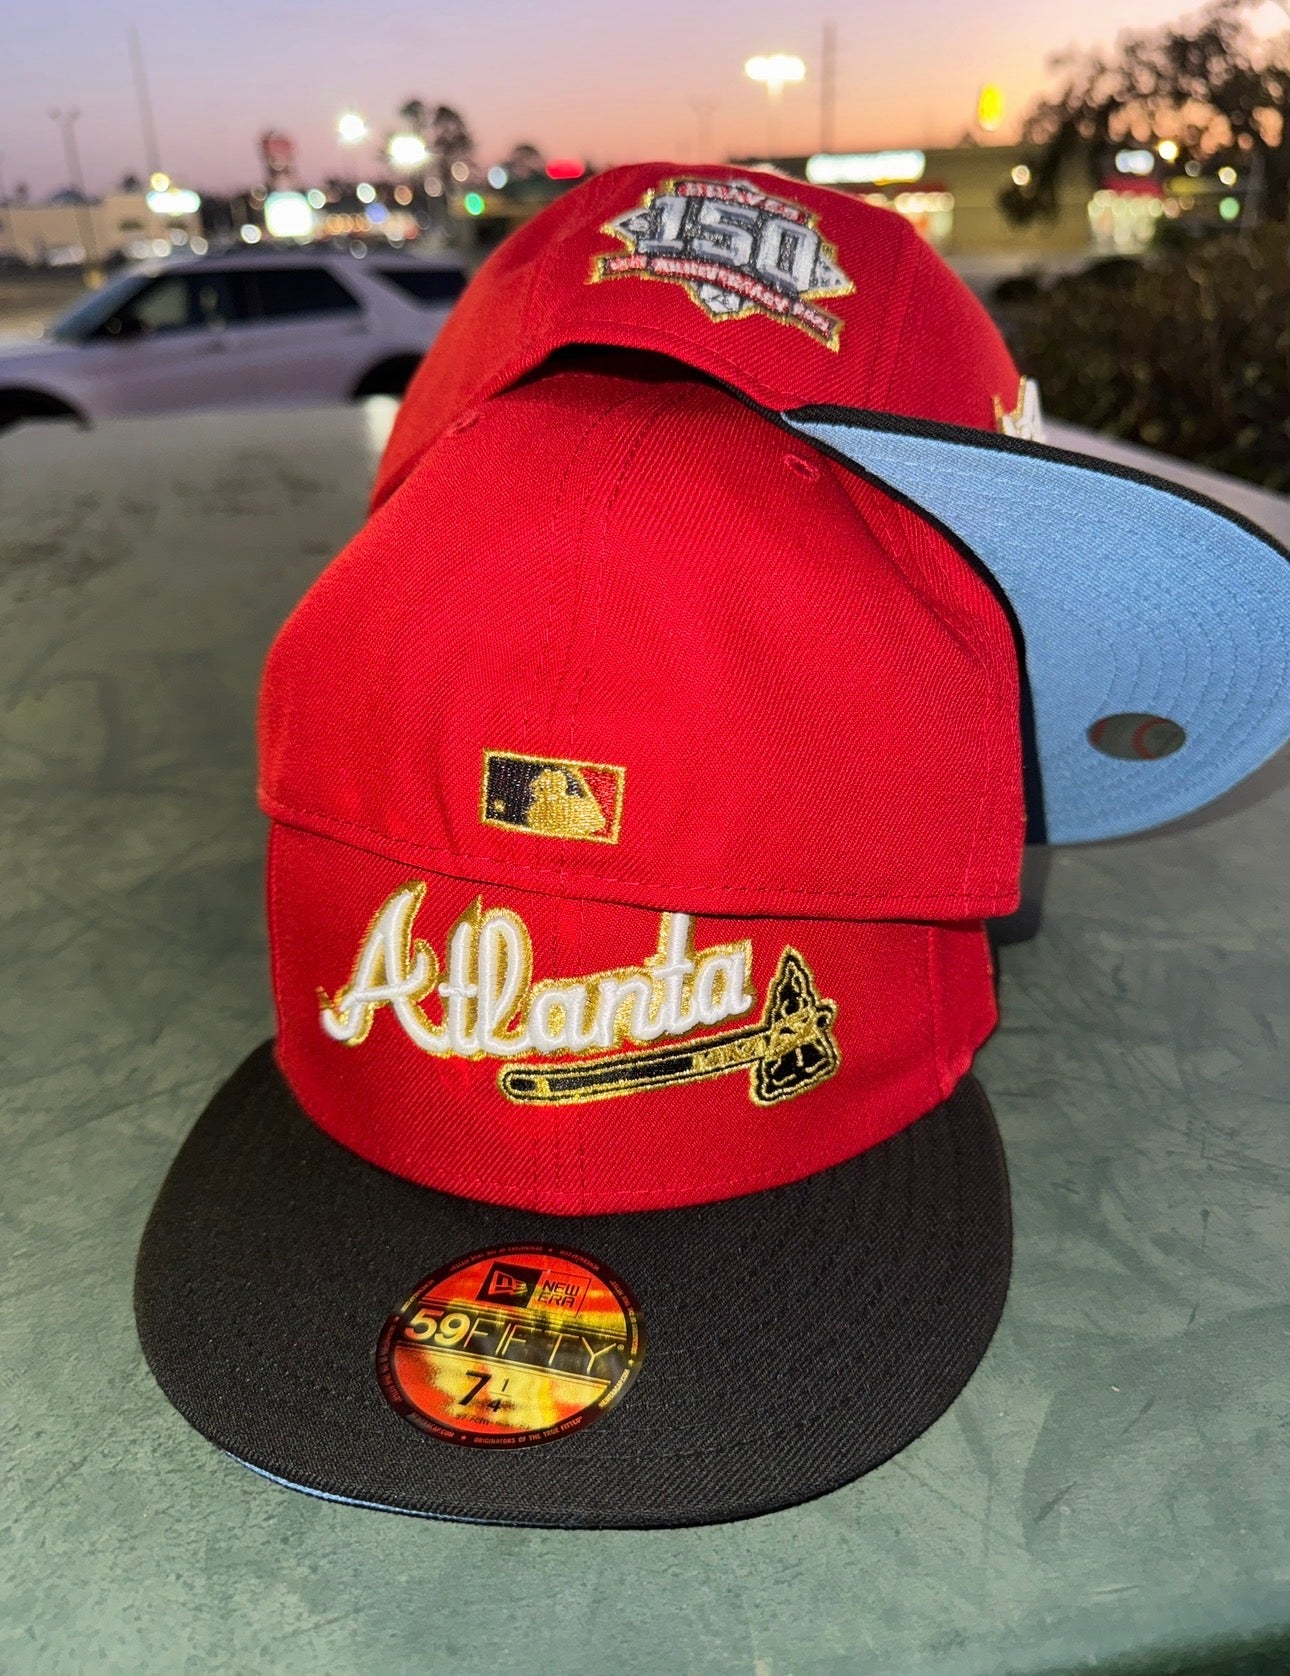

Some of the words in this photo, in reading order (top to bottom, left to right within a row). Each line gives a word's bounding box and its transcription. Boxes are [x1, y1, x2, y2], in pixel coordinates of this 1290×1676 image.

[635, 196, 820, 298] 150
[315, 881, 757, 1060] Atlanta
[538, 1292, 577, 1308] ERA
[542, 1279, 582, 1296] NEW
[404, 1308, 617, 1374] 59FIFTY
[458, 1370, 492, 1406] 7
